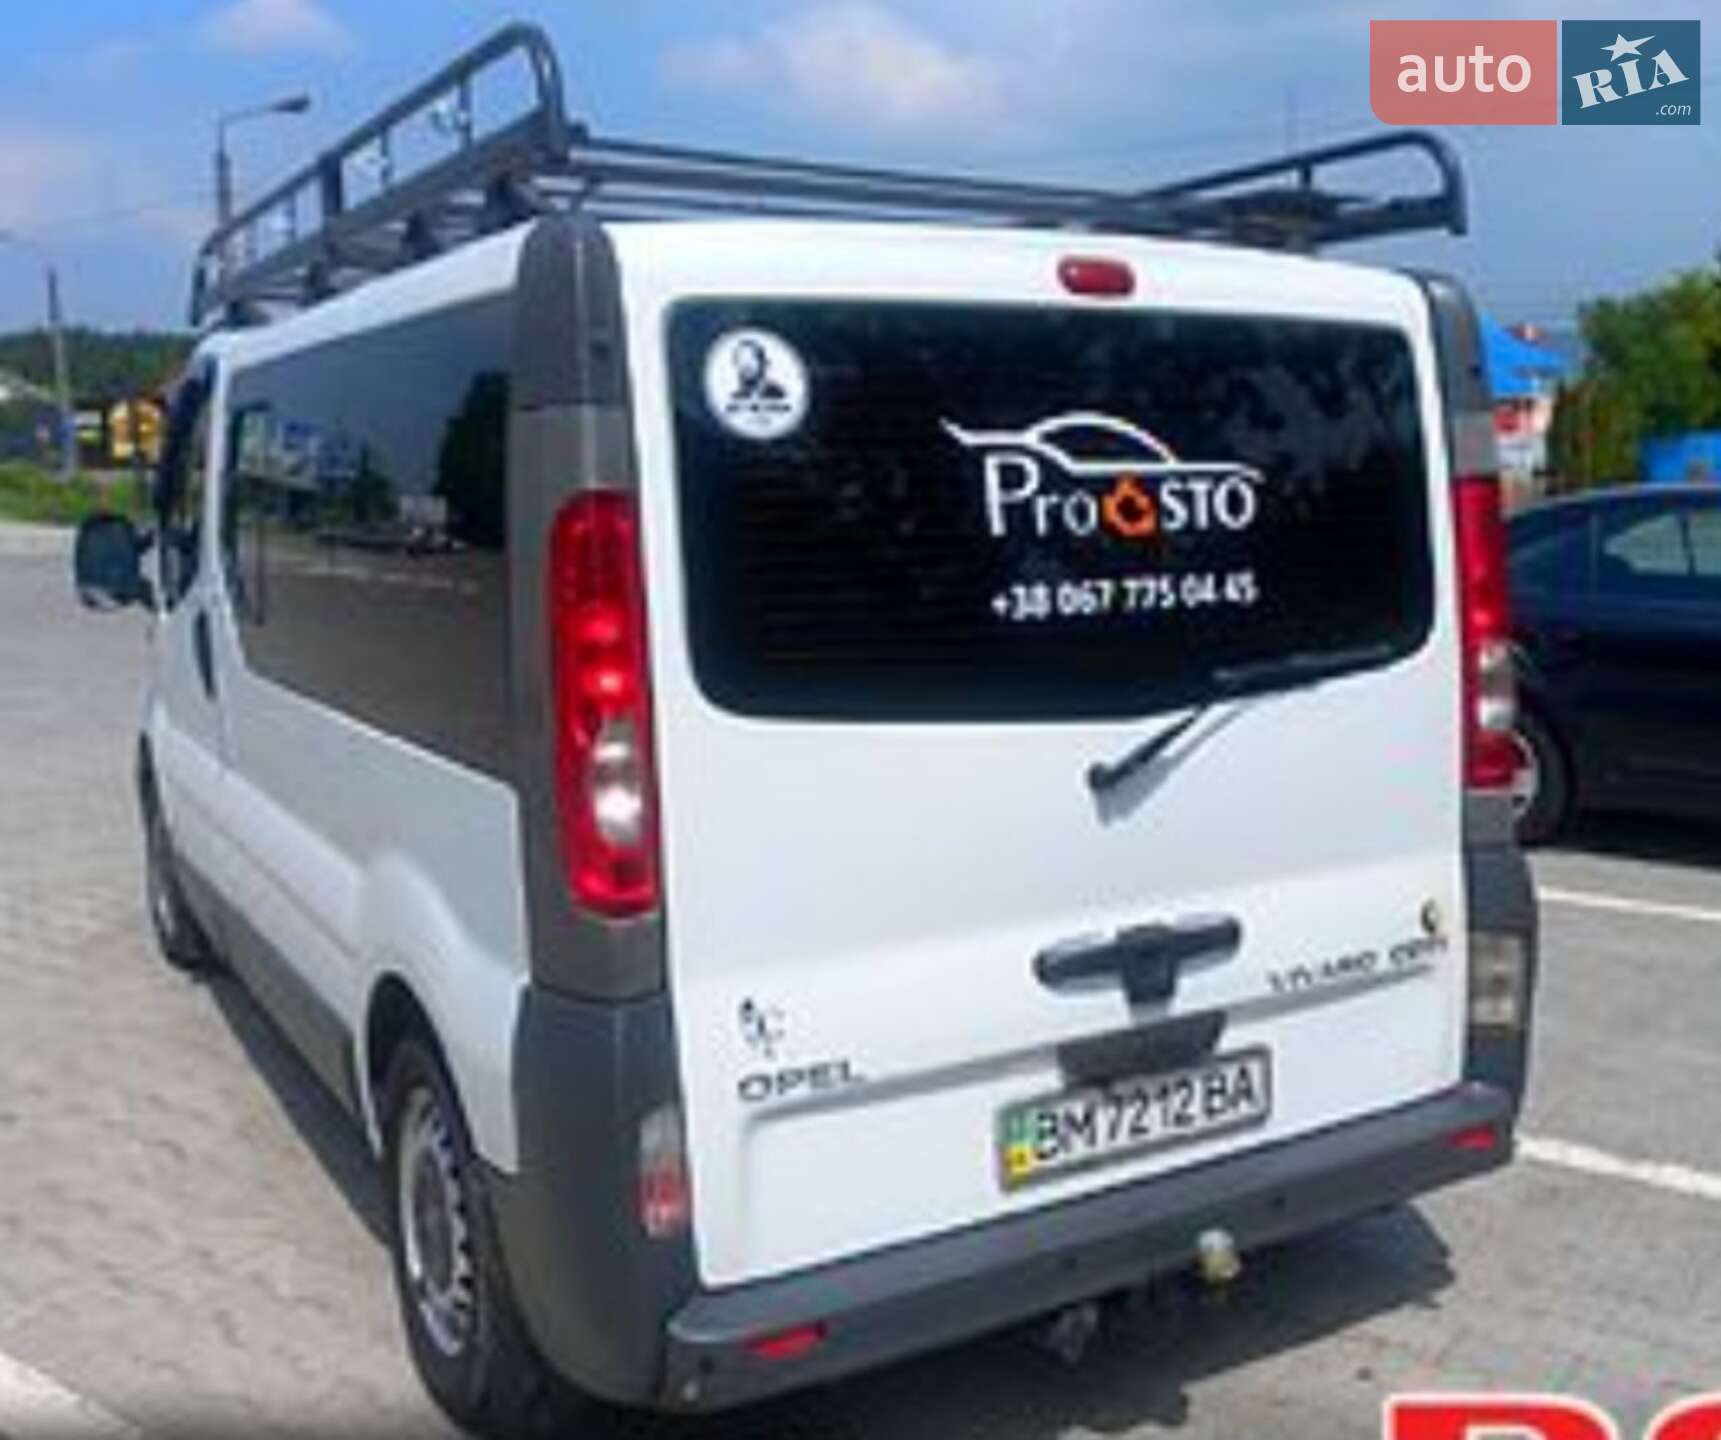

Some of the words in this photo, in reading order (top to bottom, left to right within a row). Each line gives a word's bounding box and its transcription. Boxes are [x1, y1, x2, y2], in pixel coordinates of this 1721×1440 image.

[1056, 577, 1113, 615] 067
[1122, 574, 1176, 610] 775
[738, 1058, 867, 1101] OPEL
